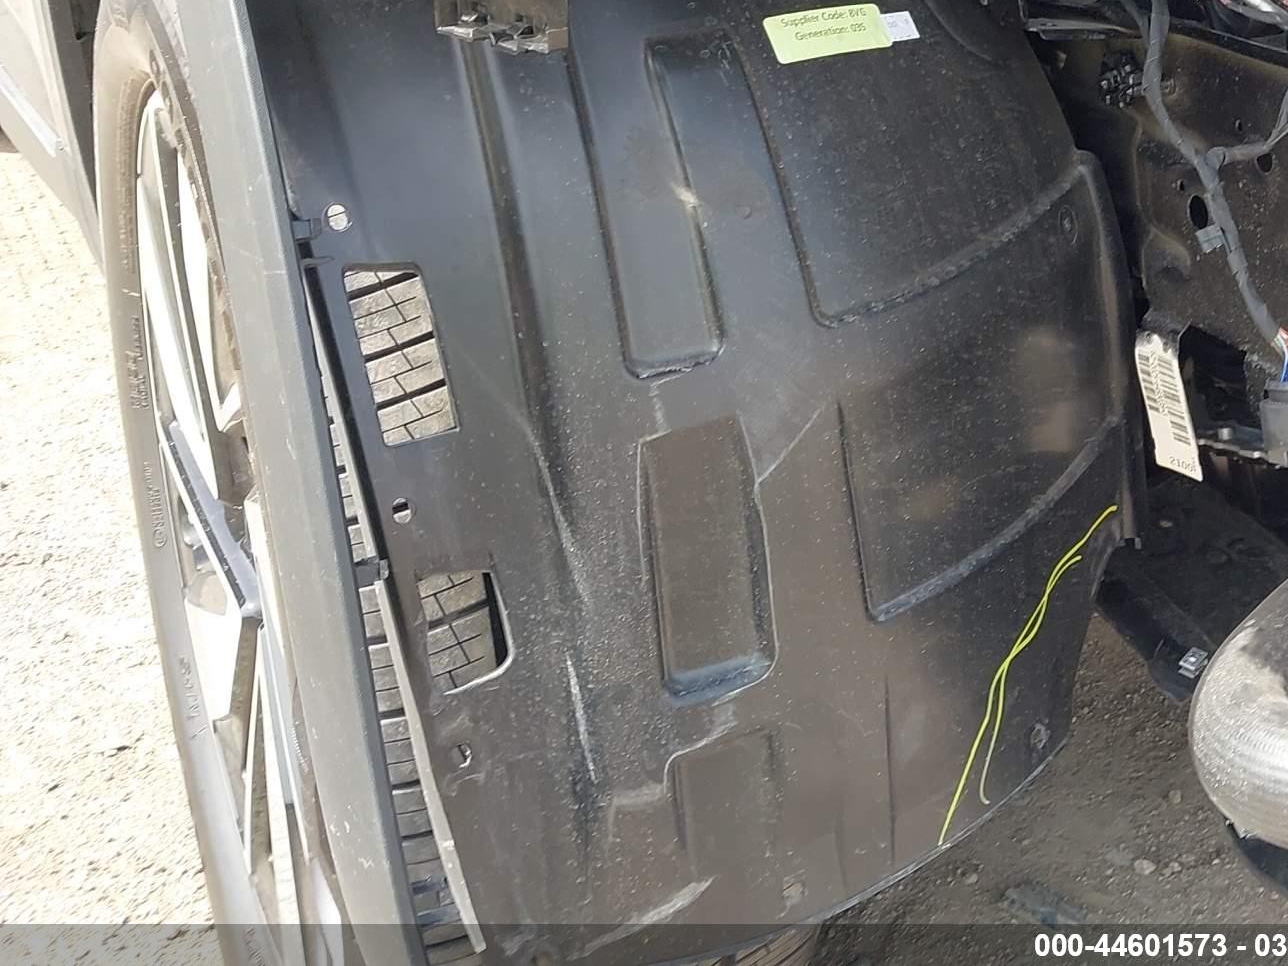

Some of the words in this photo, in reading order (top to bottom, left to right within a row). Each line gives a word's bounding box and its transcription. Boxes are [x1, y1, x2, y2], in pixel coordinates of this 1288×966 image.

[780, 14, 820, 29] Supplier
[821, 9, 848, 22] Code:
[794, 24, 849, 42] Generation:
